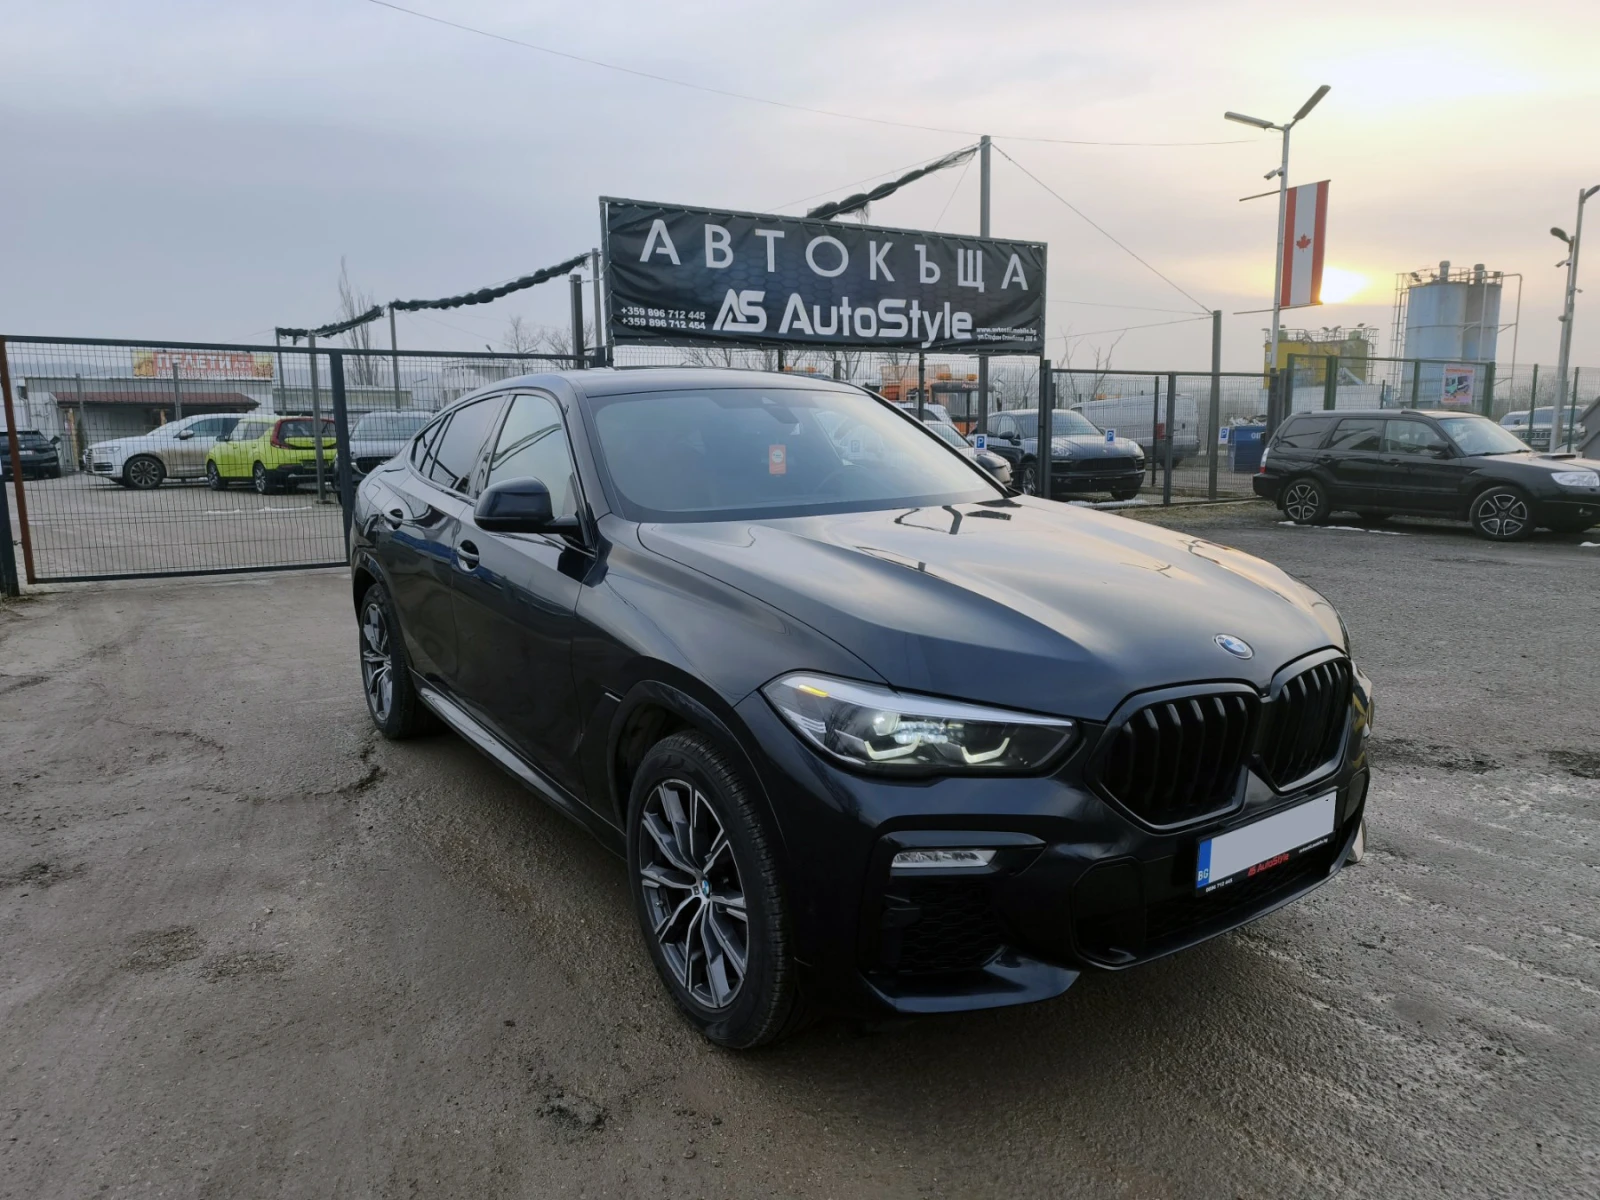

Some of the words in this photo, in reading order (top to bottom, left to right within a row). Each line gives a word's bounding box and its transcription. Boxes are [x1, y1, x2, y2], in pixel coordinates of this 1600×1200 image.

[621, 306, 645, 316] +359
[647, 308, 666, 318] 896
[668, 310, 686, 319] 712
[688, 311, 706, 320] 445
[712, 288, 767, 333] AS
[778, 292, 973, 349] AutoStyle
[622, 317, 646, 326] +359
[648, 318, 667, 327] 896
[669, 319, 687, 329] 712
[688, 321, 706, 330] 454
[1198, 868, 1209, 882] BG
